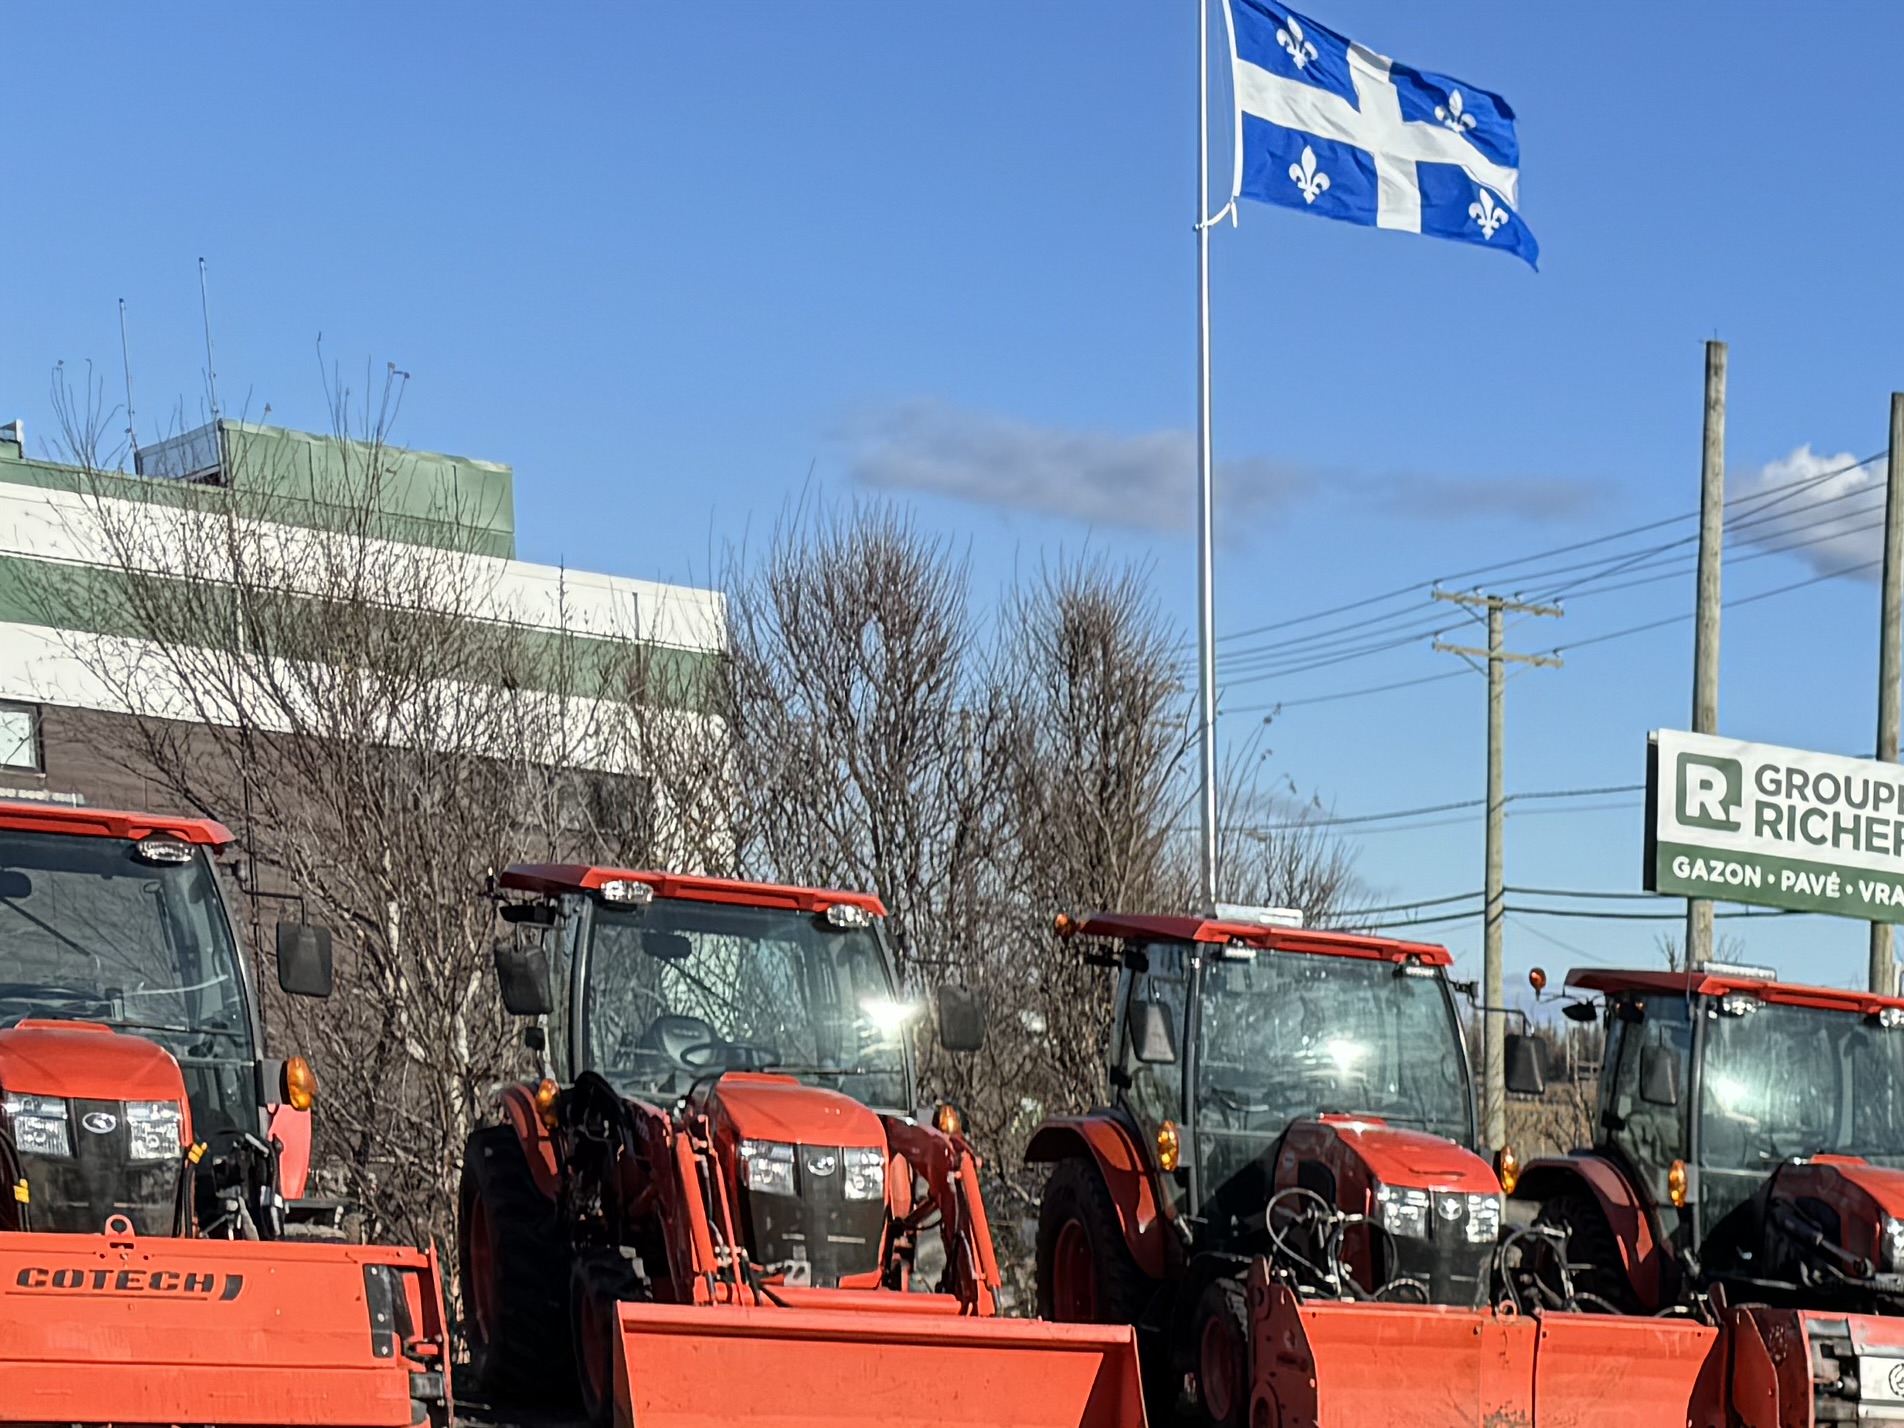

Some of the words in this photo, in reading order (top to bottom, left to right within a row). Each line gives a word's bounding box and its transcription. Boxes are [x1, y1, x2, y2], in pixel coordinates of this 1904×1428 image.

[1672, 856, 1761, 888] GAZON
[1781, 870, 1840, 898] PAVÉ
[16, 1267, 215, 1293] COTECH
